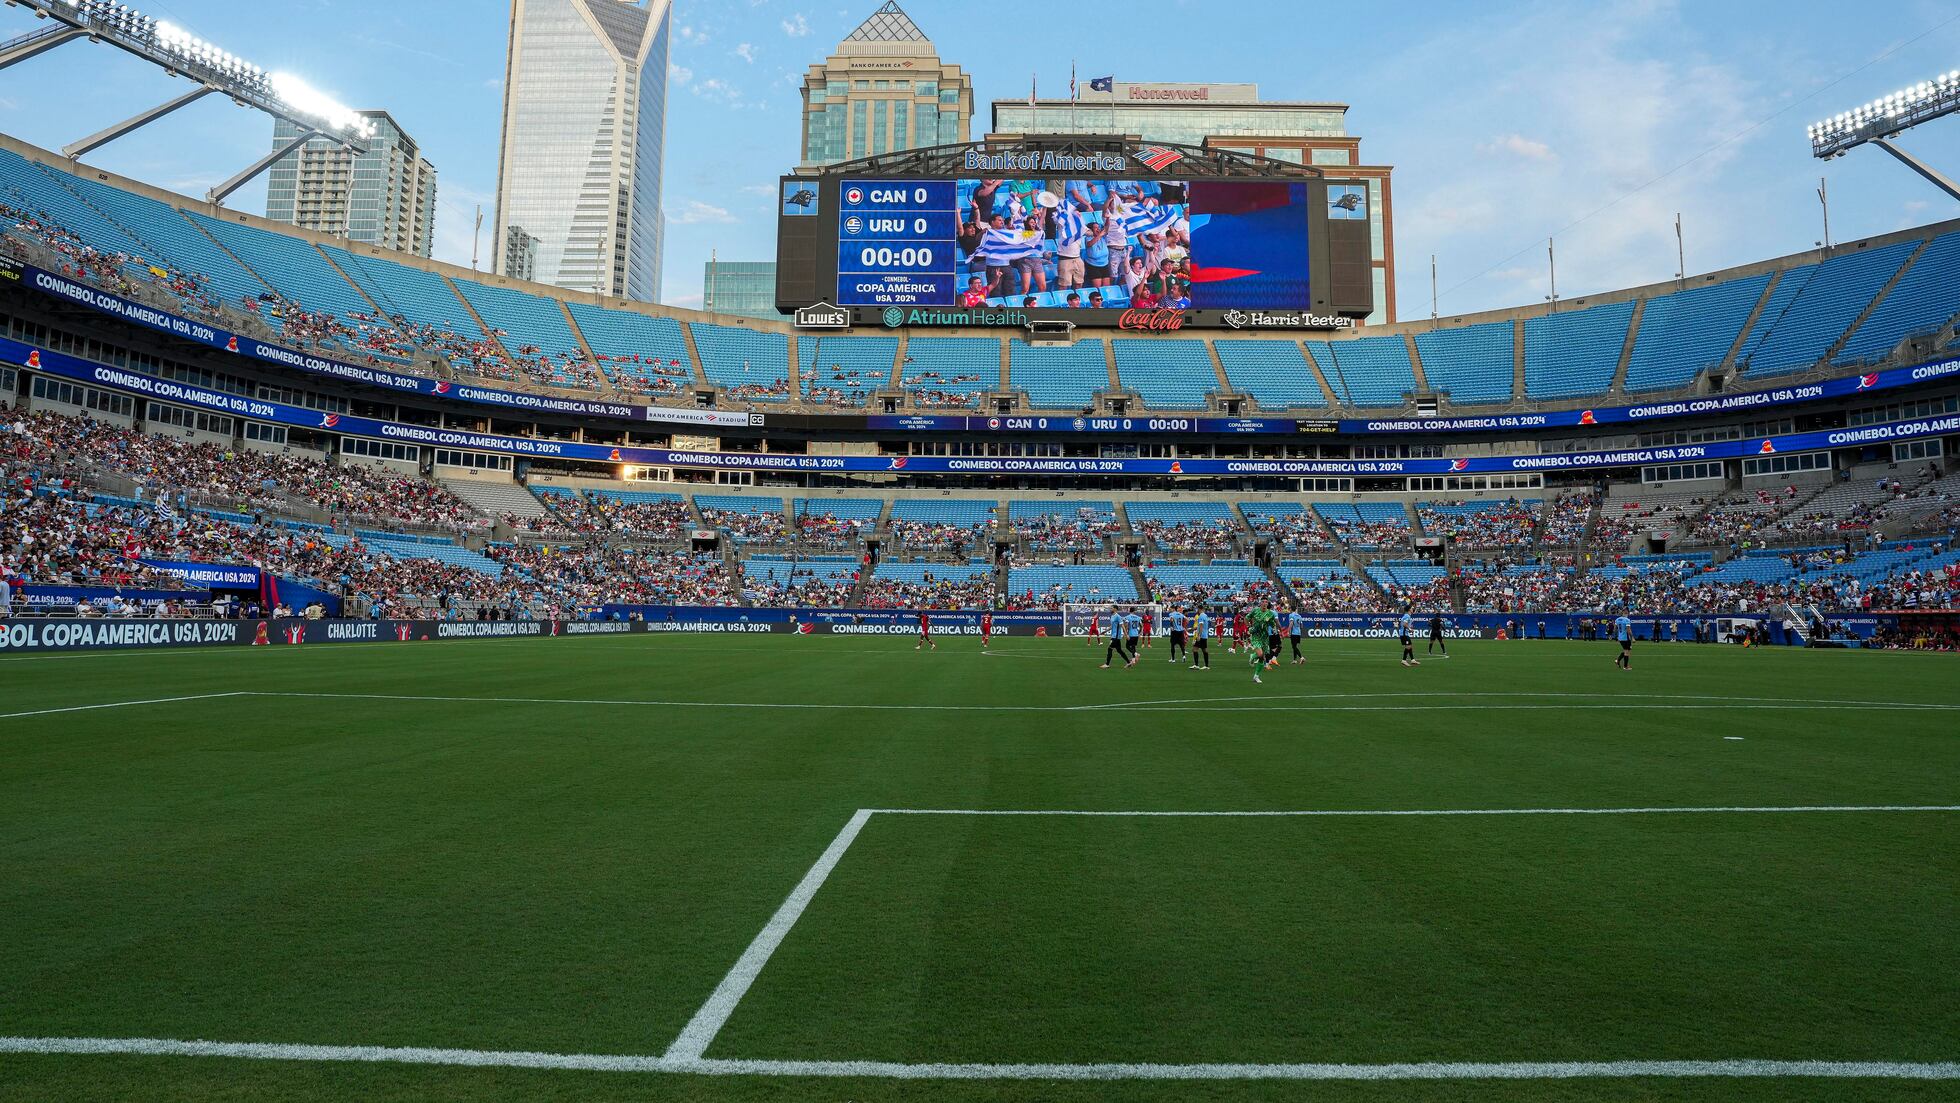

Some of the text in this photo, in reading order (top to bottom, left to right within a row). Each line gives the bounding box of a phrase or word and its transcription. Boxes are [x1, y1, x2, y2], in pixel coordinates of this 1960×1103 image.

[1129, 87, 1208, 100] Honeywell
[964, 151, 1126, 170] Bank of America
[870, 188, 927, 203] CAN 0
[869, 218, 927, 234] URU 0
[861, 248, 932, 266] 00:00
[856, 284, 936, 293] COPA AMERICA
[36, 273, 214, 342] CONMEBOL COPA AMERICA USA 2024
[800, 312, 844, 324] LOWE'S
[908, 311, 1026, 325] Atrium Health
[1250, 313, 1350, 326] Harris Teeter
[256, 344, 418, 389] CONMEBOL COPA AMERICA USA 2024
[95, 368, 273, 416] CONMEBOL COPA AMERICA USA 2024
[459, 388, 631, 416] CONMEBOL COPA AMERICA USA 2024
[1629, 386, 1823, 417] CONMEBOL COPA AMERICA USA 2024
[1006, 419, 1188, 430] CAN 0 URU 0 00:00
[1368, 416, 1546, 430] CONMEBOL COPA AMERICA USA 2024
[1829, 418, 1960, 444] CONMEBOL COPA AME
[382, 425, 561, 454] CONMEBOL COPA AMERICA USA 2024
[668, 454, 844, 467] CONMEBOL COPA AMERICA USA 2024
[1513, 448, 1705, 467] CONMEBOL COPA AMERICA USA 2024
[949, 460, 1123, 470] CONMEBOL COPA AMERICA USA 2024
[1228, 462, 1403, 472] CONMEBOL COPA AMERICA USA 2024
[190, 570, 223, 581] AMERICA
[225, 572, 238, 582] USA
[239, 573, 256, 583] 2024
[42, 624, 94, 646] COPA
[96, 624, 170, 645] AMERICA
[174, 623, 201, 642] USA
[204, 623, 236, 642] 2024
[328, 623, 376, 638] CHARLOTTE
[438, 623, 540, 636] CONMEBOL COPA AMERICA USA 2024
[683, 623, 725, 631] AMERICA
[728, 624, 746, 632] USA
[832, 625, 887, 633] CONMEBOL
[888, 625, 915, 633] COPA
[964, 626, 982, 634] USA
[990, 626, 1008, 634] 024
[1308, 629, 1481, 638] CONMEBOL COPA 2024
